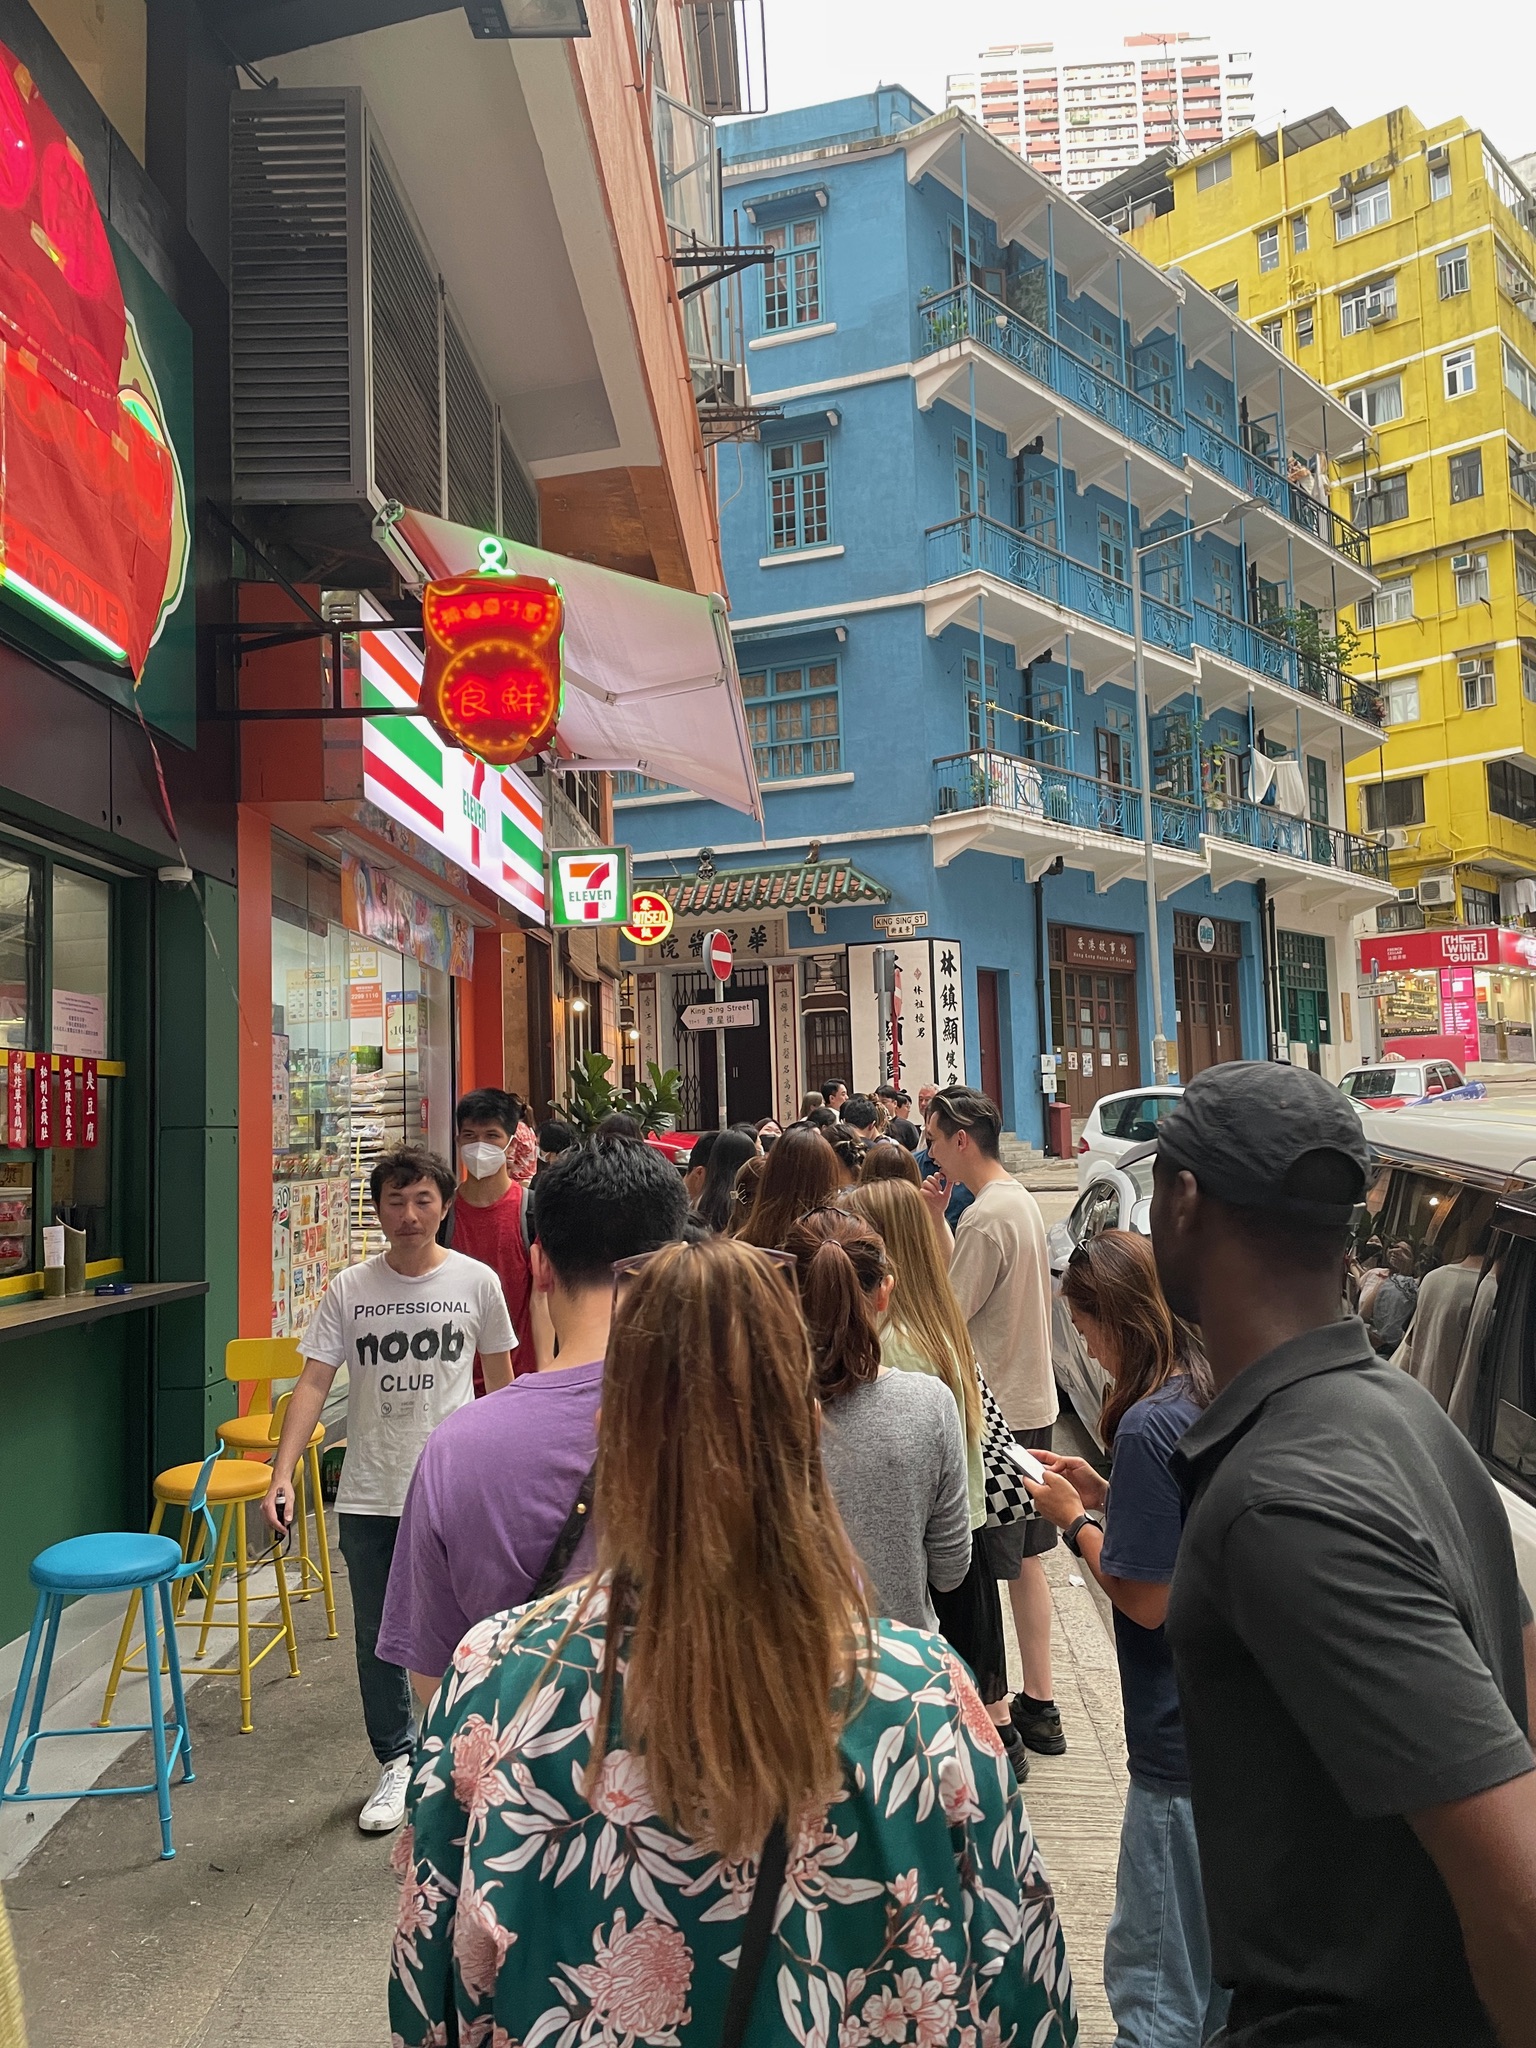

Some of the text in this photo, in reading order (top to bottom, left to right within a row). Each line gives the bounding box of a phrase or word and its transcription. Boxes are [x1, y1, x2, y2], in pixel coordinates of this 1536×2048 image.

[569, 862, 610, 919] 7
[876, 916, 924, 926] KING SING ST
[1444, 935, 1465, 945] THE
[1447, 944, 1477, 953] WINE
[1450, 952, 1486, 962] GUILD
[690, 1008, 706, 1016] King
[726, 1004, 750, 1012] Street
[706, 1014, 735, 1025] 景星街
[86, 1069, 95, 1142] 臭豆腐
[354, 1301, 471, 1320] PROFESSIONAL
[356, 1320, 465, 1366] noob
[380, 1374, 434, 1393] CLUB
